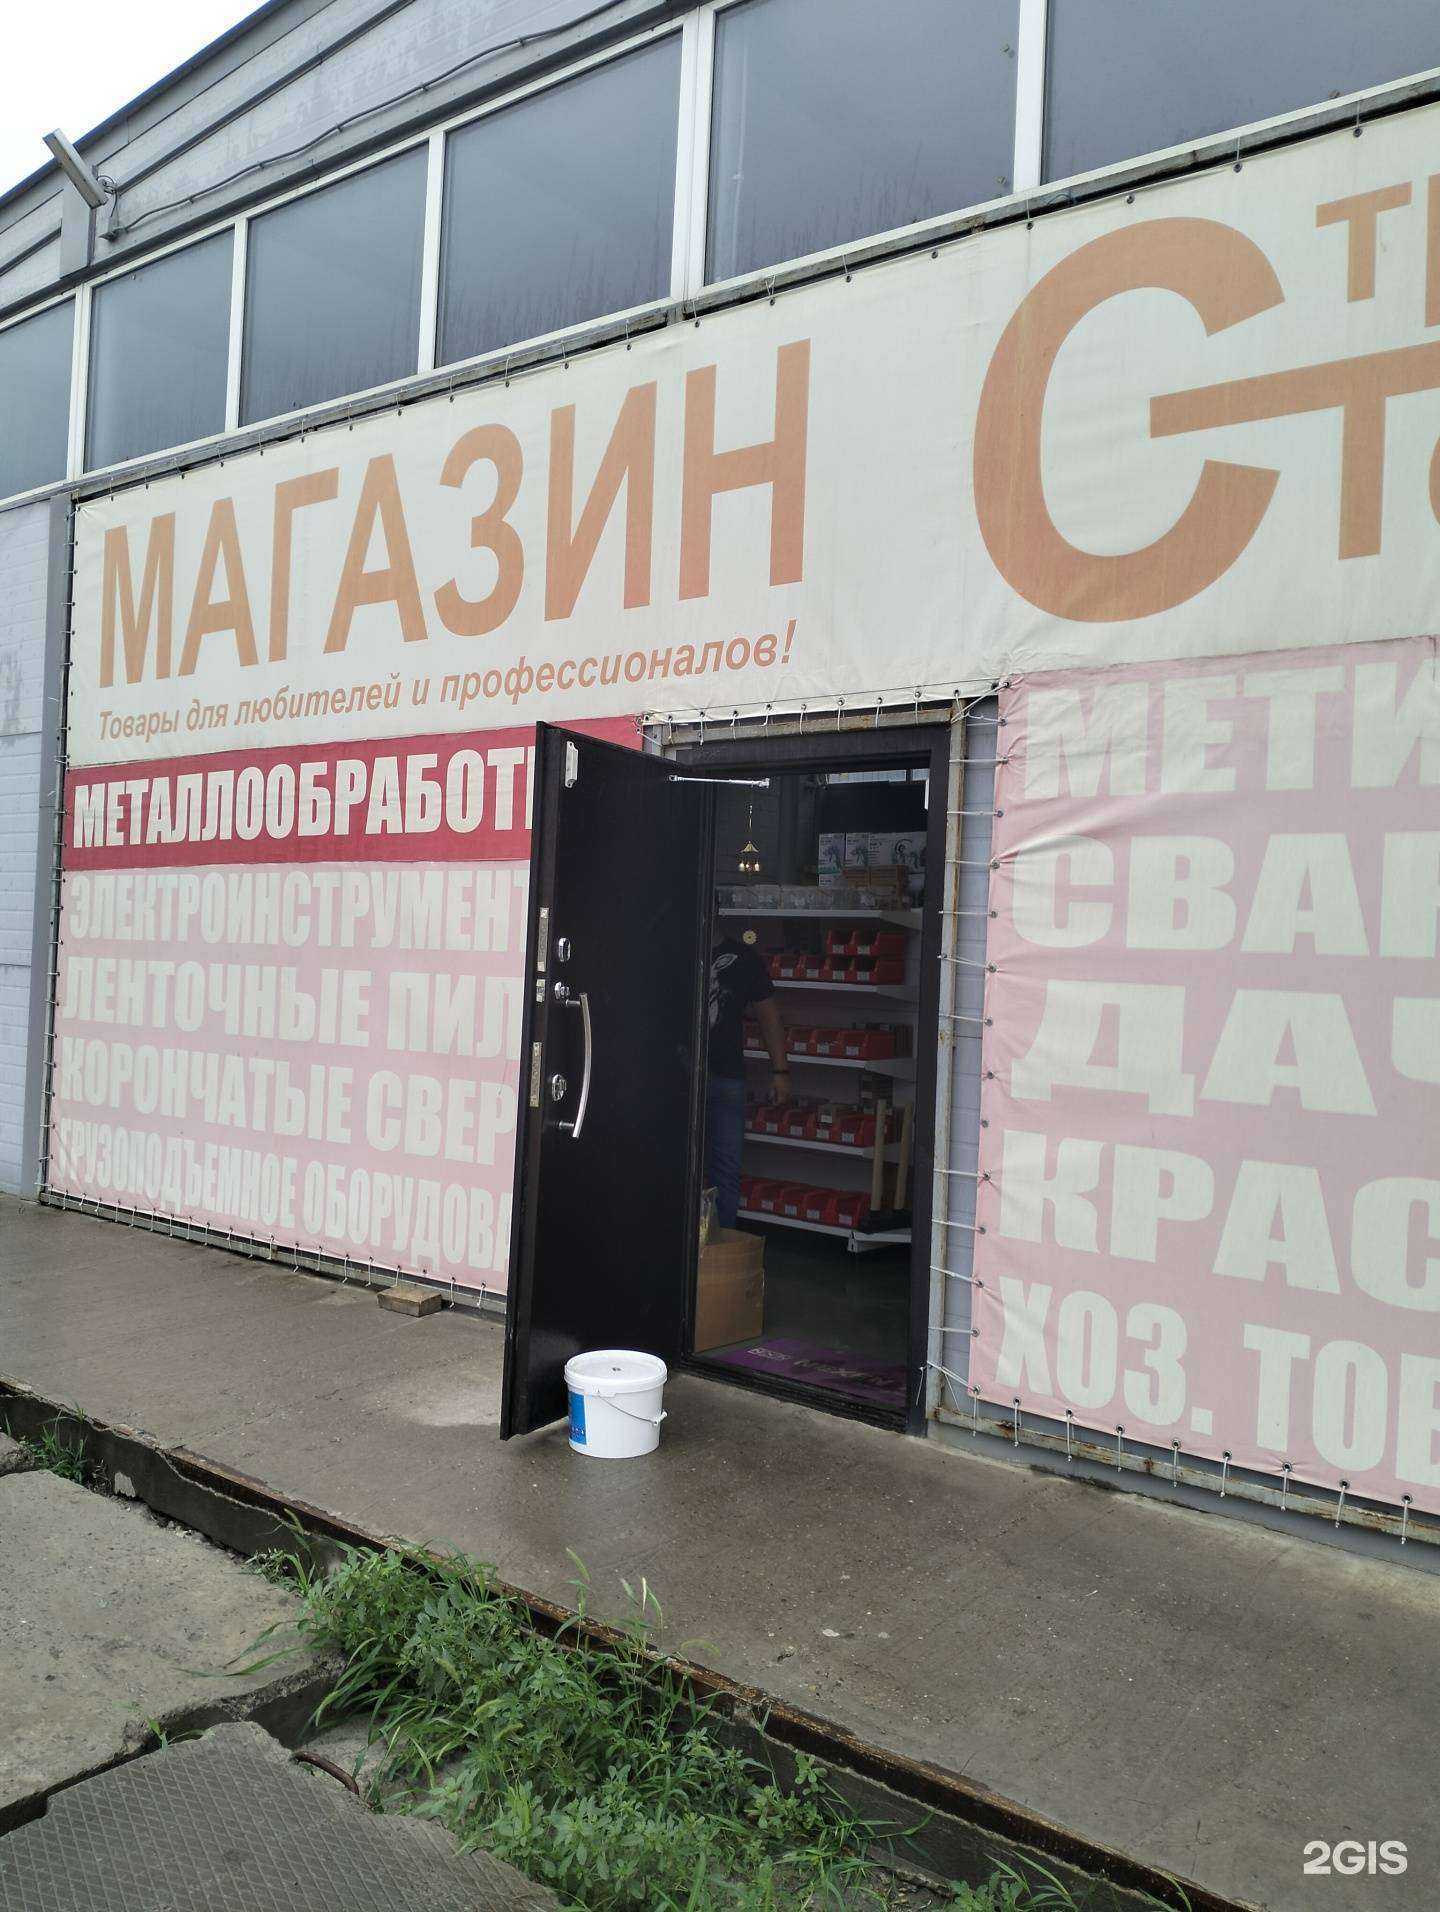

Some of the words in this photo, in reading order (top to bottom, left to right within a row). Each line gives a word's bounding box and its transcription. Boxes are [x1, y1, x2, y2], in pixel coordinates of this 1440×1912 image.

[99, 338, 811, 688] МАГАЗИН
[98, 709, 180, 743] Товары
[186, 698, 229, 731] для
[234, 672, 403, 726] любителей
[412, 678, 431, 706] и
[439, 617, 799, 711] профессионалов!
[72, 745, 536, 849] МЕТАЛЛООБРАБОТ
[62, 955, 376, 1048] ЛЕНТОЧНЫЕ
[60, 1035, 355, 1145] КОРОНЧАТЫЕ
[366, 1069, 515, 1166] СВЕР
[998, 1128, 1440, 1313] КРАС
[995, 1276, 1213, 1436] ХОЗ.
